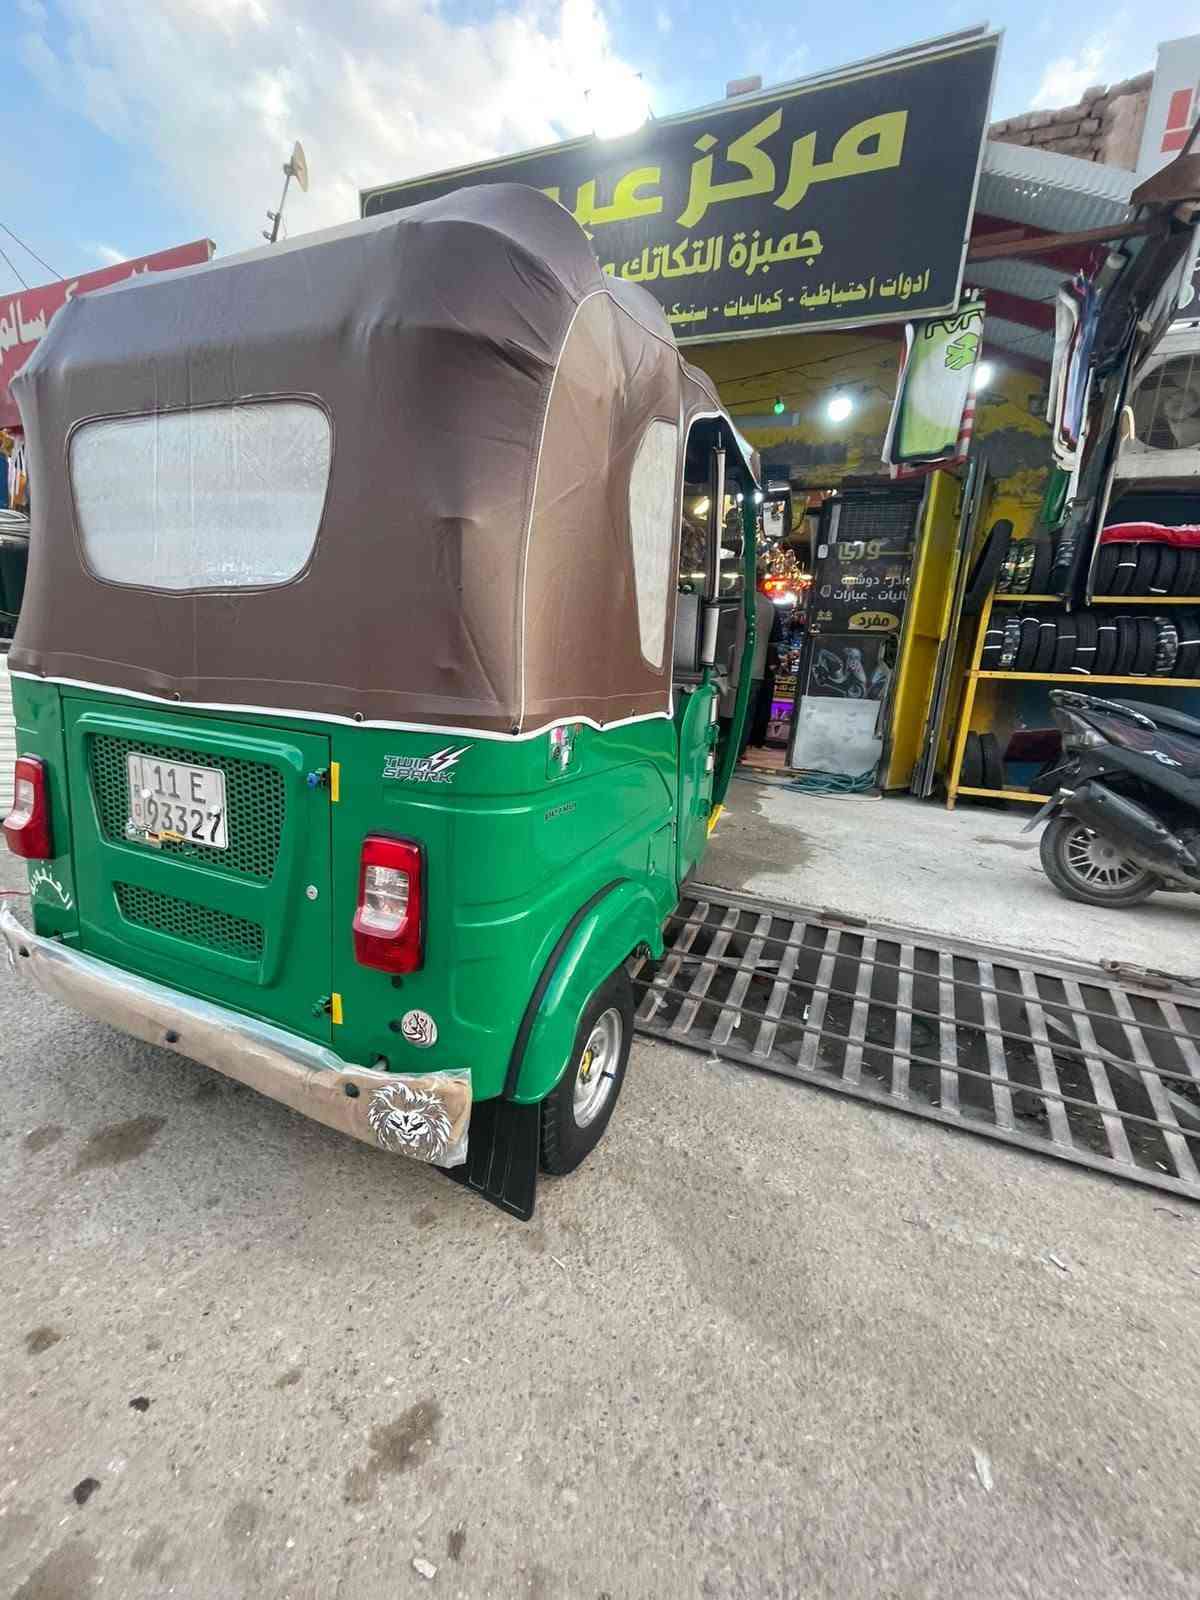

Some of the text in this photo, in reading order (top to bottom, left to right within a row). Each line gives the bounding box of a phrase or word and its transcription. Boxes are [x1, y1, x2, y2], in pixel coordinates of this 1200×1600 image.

[676, 107, 908, 229] مركز
[621, 233, 724, 282] التكاتك
[800, 276, 875, 311] احتياطية
[880, 268, 930, 300] ادوات
[723, 288, 783, 320] كماليات
[859, 613, 889, 629] مفرد
[381, 767, 456, 784] SPARK
[383, 754, 433, 772] TWIN
[153, 765, 206, 805] 11 E
[147, 797, 222, 843] 93327
